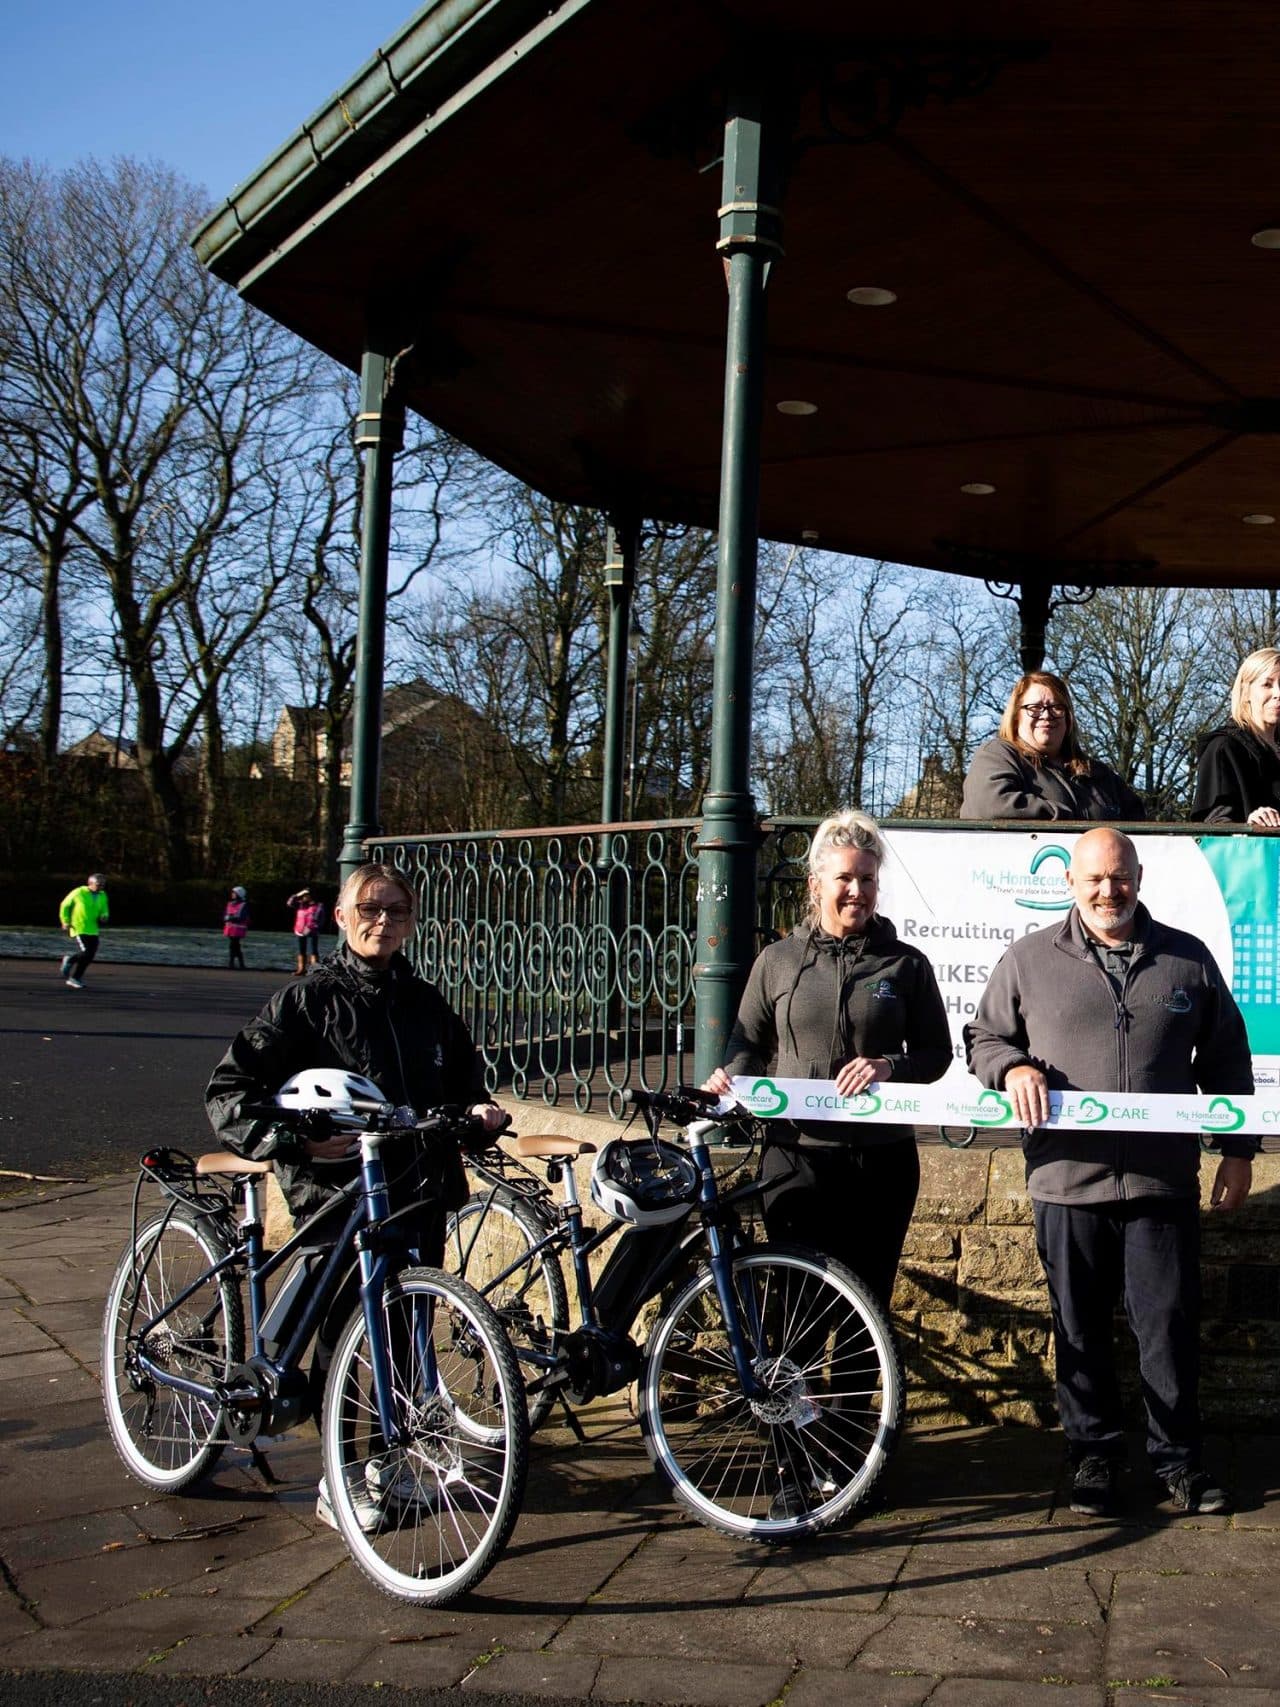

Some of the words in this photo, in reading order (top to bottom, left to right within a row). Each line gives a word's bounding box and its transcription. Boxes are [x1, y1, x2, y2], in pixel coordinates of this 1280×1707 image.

[972, 870, 994, 889] My
[1000, 870, 1067, 886] Homecare
[903, 919, 1015, 947] Recruiting
[932, 964, 989, 984] IKES
[804, 1095, 850, 1110] CYCLE
[859, 1098, 867, 1111] 2
[884, 1098, 921, 1113] CARE
[946, 1102, 960, 1114] My
[961, 1102, 999, 1114] Homecare
[1050, 1104, 1075, 1118] CLE
[1085, 1105, 1094, 1118] 2
[1111, 1107, 1150, 1120] CARE
[1176, 1110, 1189, 1121] My
[1191, 1111, 1230, 1121] Homecare
